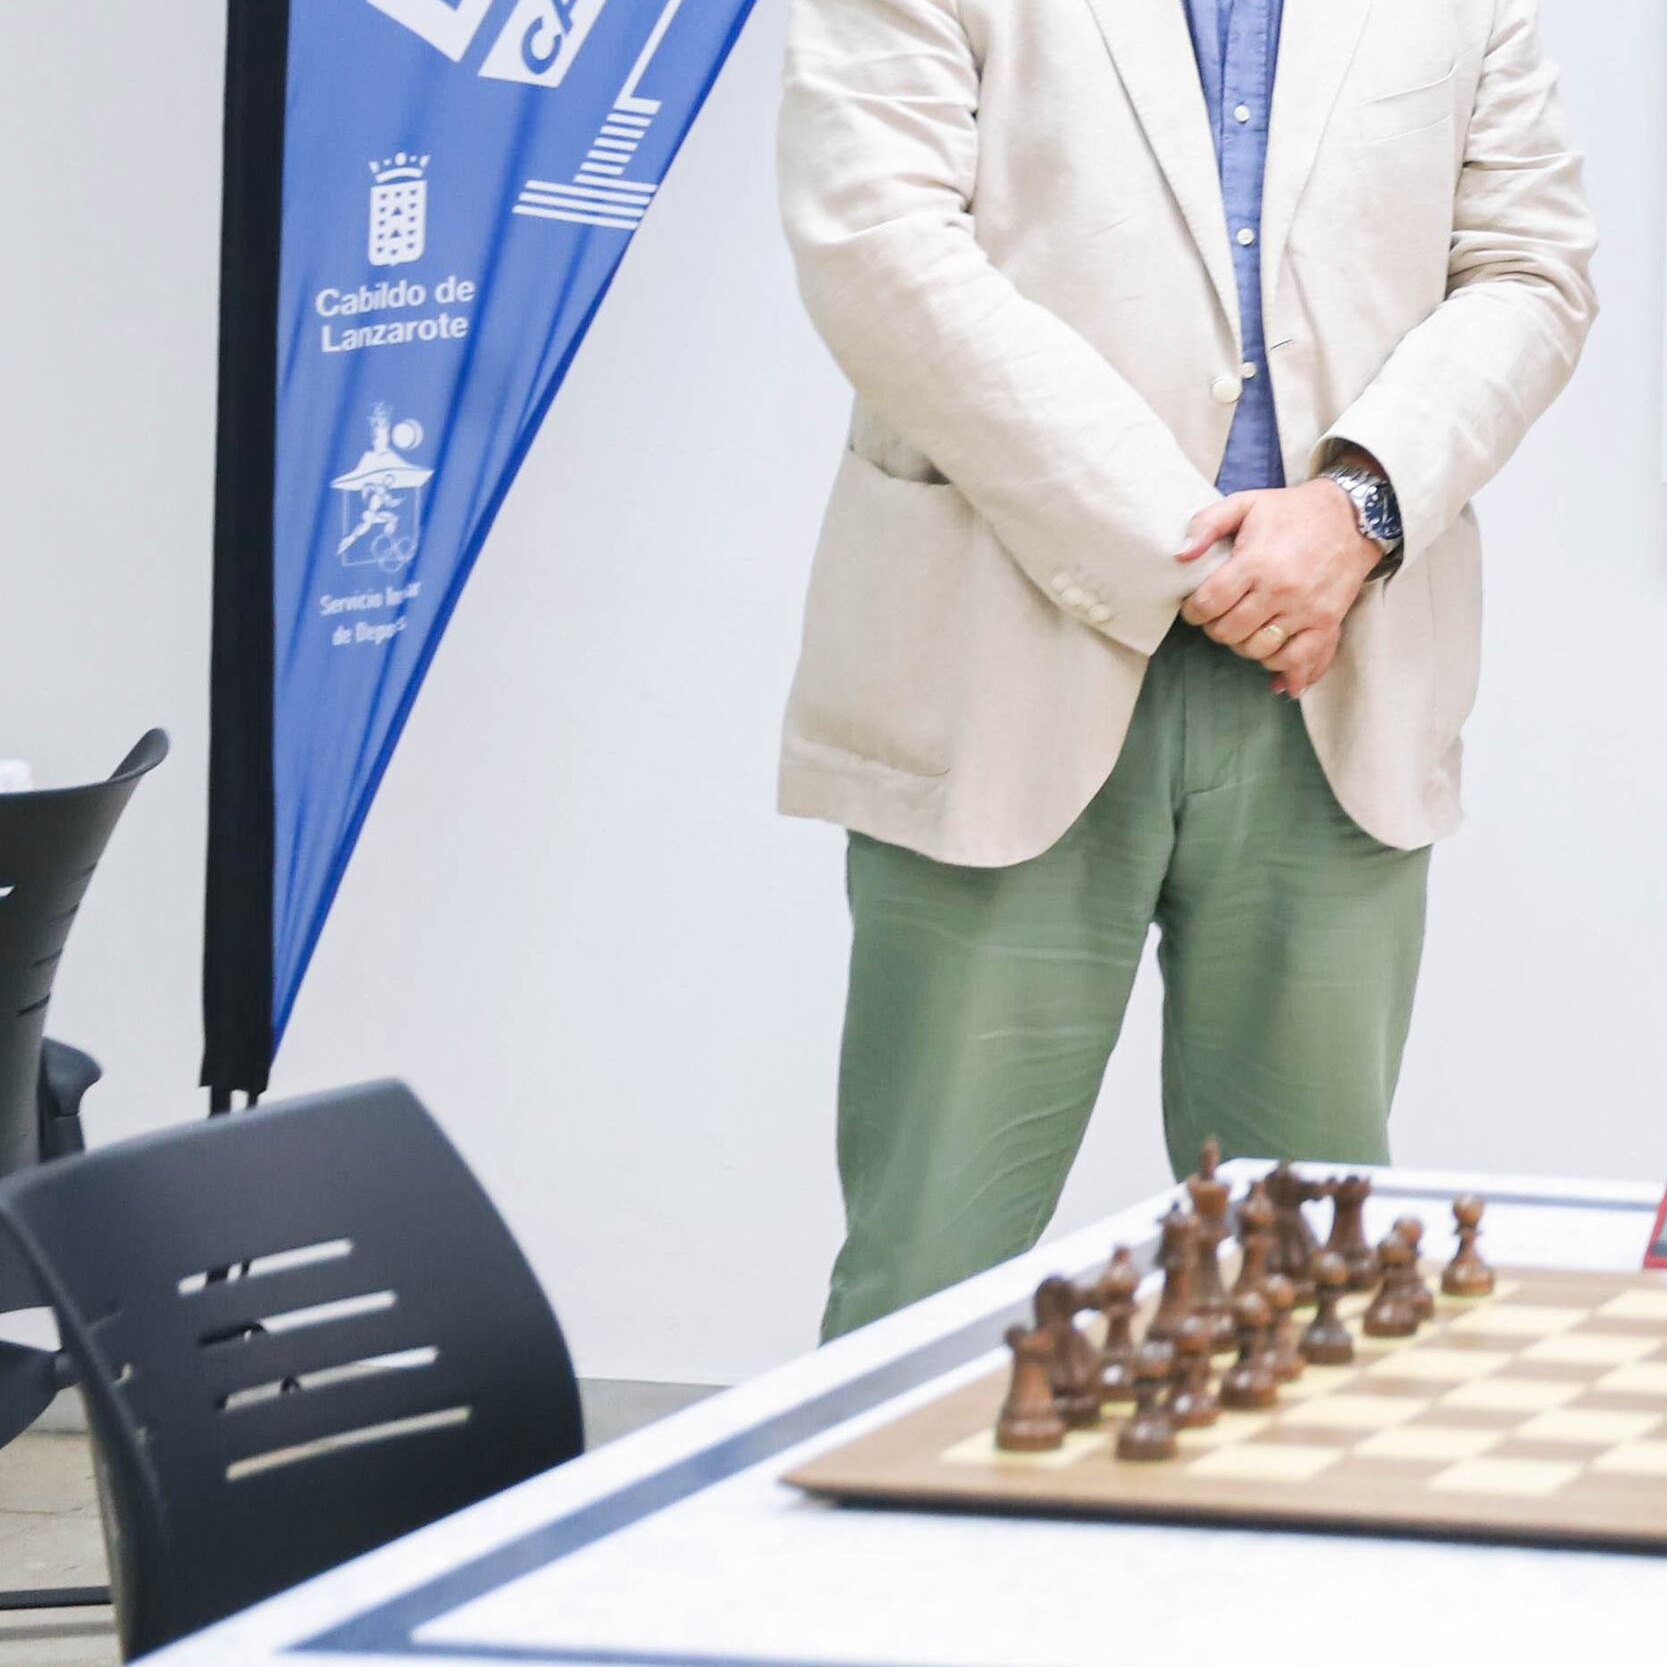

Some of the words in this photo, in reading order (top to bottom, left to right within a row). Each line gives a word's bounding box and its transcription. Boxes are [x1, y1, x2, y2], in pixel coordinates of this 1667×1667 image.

[316, 279, 426, 317] Cabildo
[434, 275, 476, 303] de
[323, 312, 468, 353] Lanzarote
